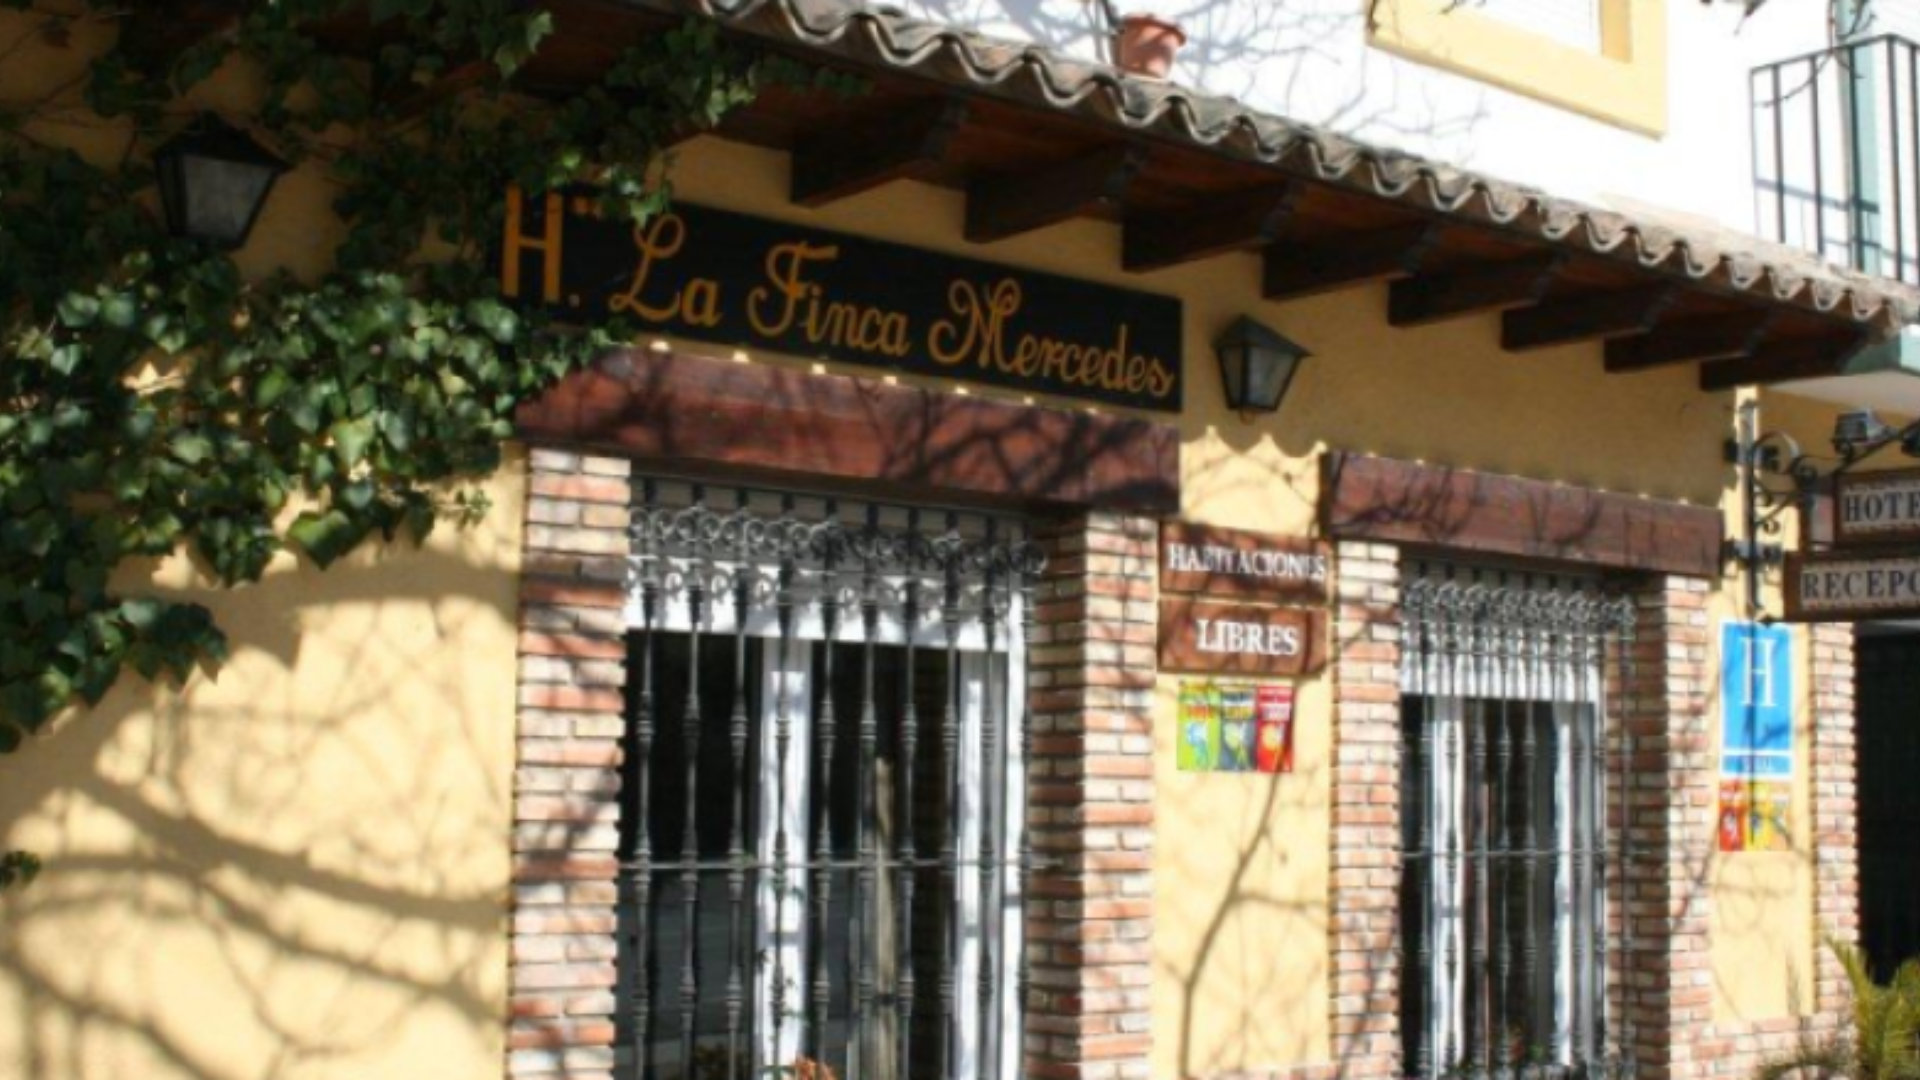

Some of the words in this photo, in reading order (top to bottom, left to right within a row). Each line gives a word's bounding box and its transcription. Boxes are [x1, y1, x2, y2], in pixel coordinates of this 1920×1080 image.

[608, 213, 723, 326] La
[748, 243, 912, 357] Finca
[926, 278, 1175, 397] Mercedes
[1168, 543, 1327, 582] HABITACIONES
[1196, 618, 1299, 656] LIBRES
[1739, 637, 1777, 707] H
